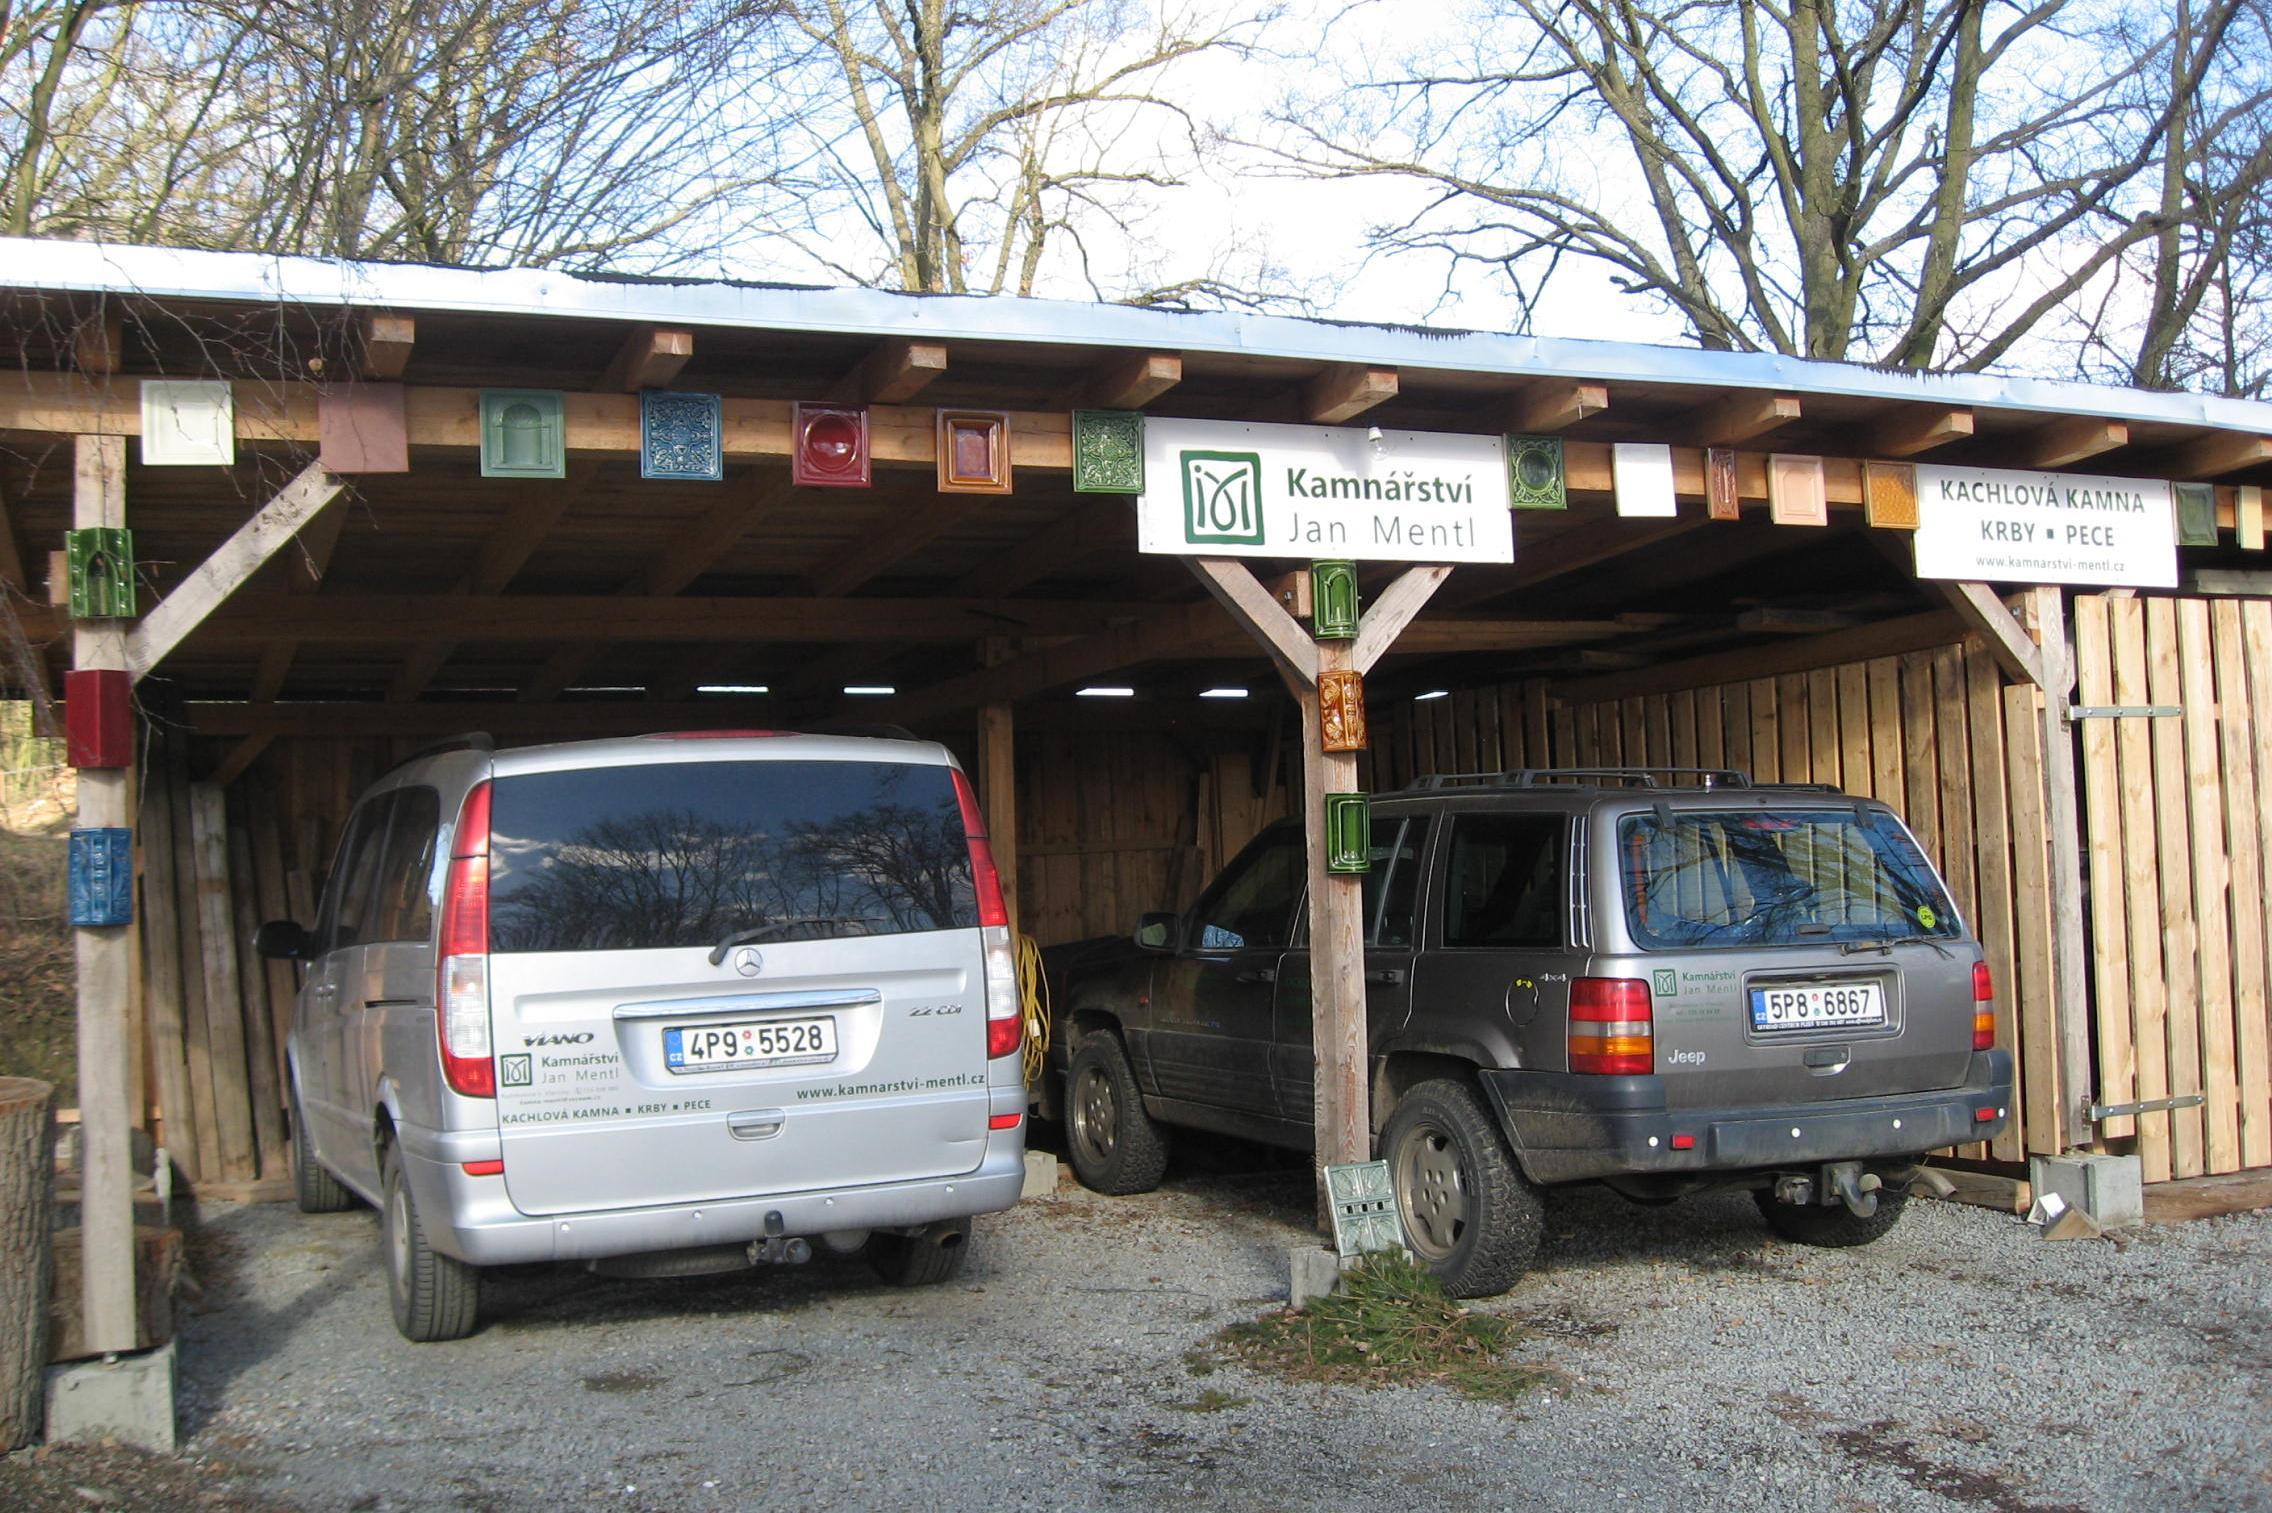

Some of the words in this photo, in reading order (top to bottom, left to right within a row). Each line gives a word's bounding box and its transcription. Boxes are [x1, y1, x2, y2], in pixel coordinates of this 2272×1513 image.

[1287, 468, 1474, 504] Kamnářství
[1940, 480, 2060, 508] KACHLOVÁ
[2066, 488, 2145, 513] KAMNA
[1289, 512, 1347, 543] Jan
[1373, 515, 1475, 547] Mentl
[1981, 520, 2036, 542] KRBY
[2066, 524, 2115, 547] PECE
[1975, 555, 2125, 572] www.kamnarstvi-mentl.cz
[1770, 993, 1808, 1019] 5P8
[1824, 989, 1870, 1016] 6867
[690, 1031, 738, 1059] 4P9
[758, 1025, 823, 1054] 5528
[669, 1053, 682, 1062] CZ
[1668, 1049, 1706, 1066] Jeep
[542, 1072, 566, 1084] Jan
[576, 1067, 618, 1081] Mentl
[797, 1073, 985, 1099] www.kamnarstvi-mentl.cz
[573, 1106, 620, 1119] KAMNA
[638, 1103, 666, 1114] KRBY
[684, 1100, 712, 1110] PECE
